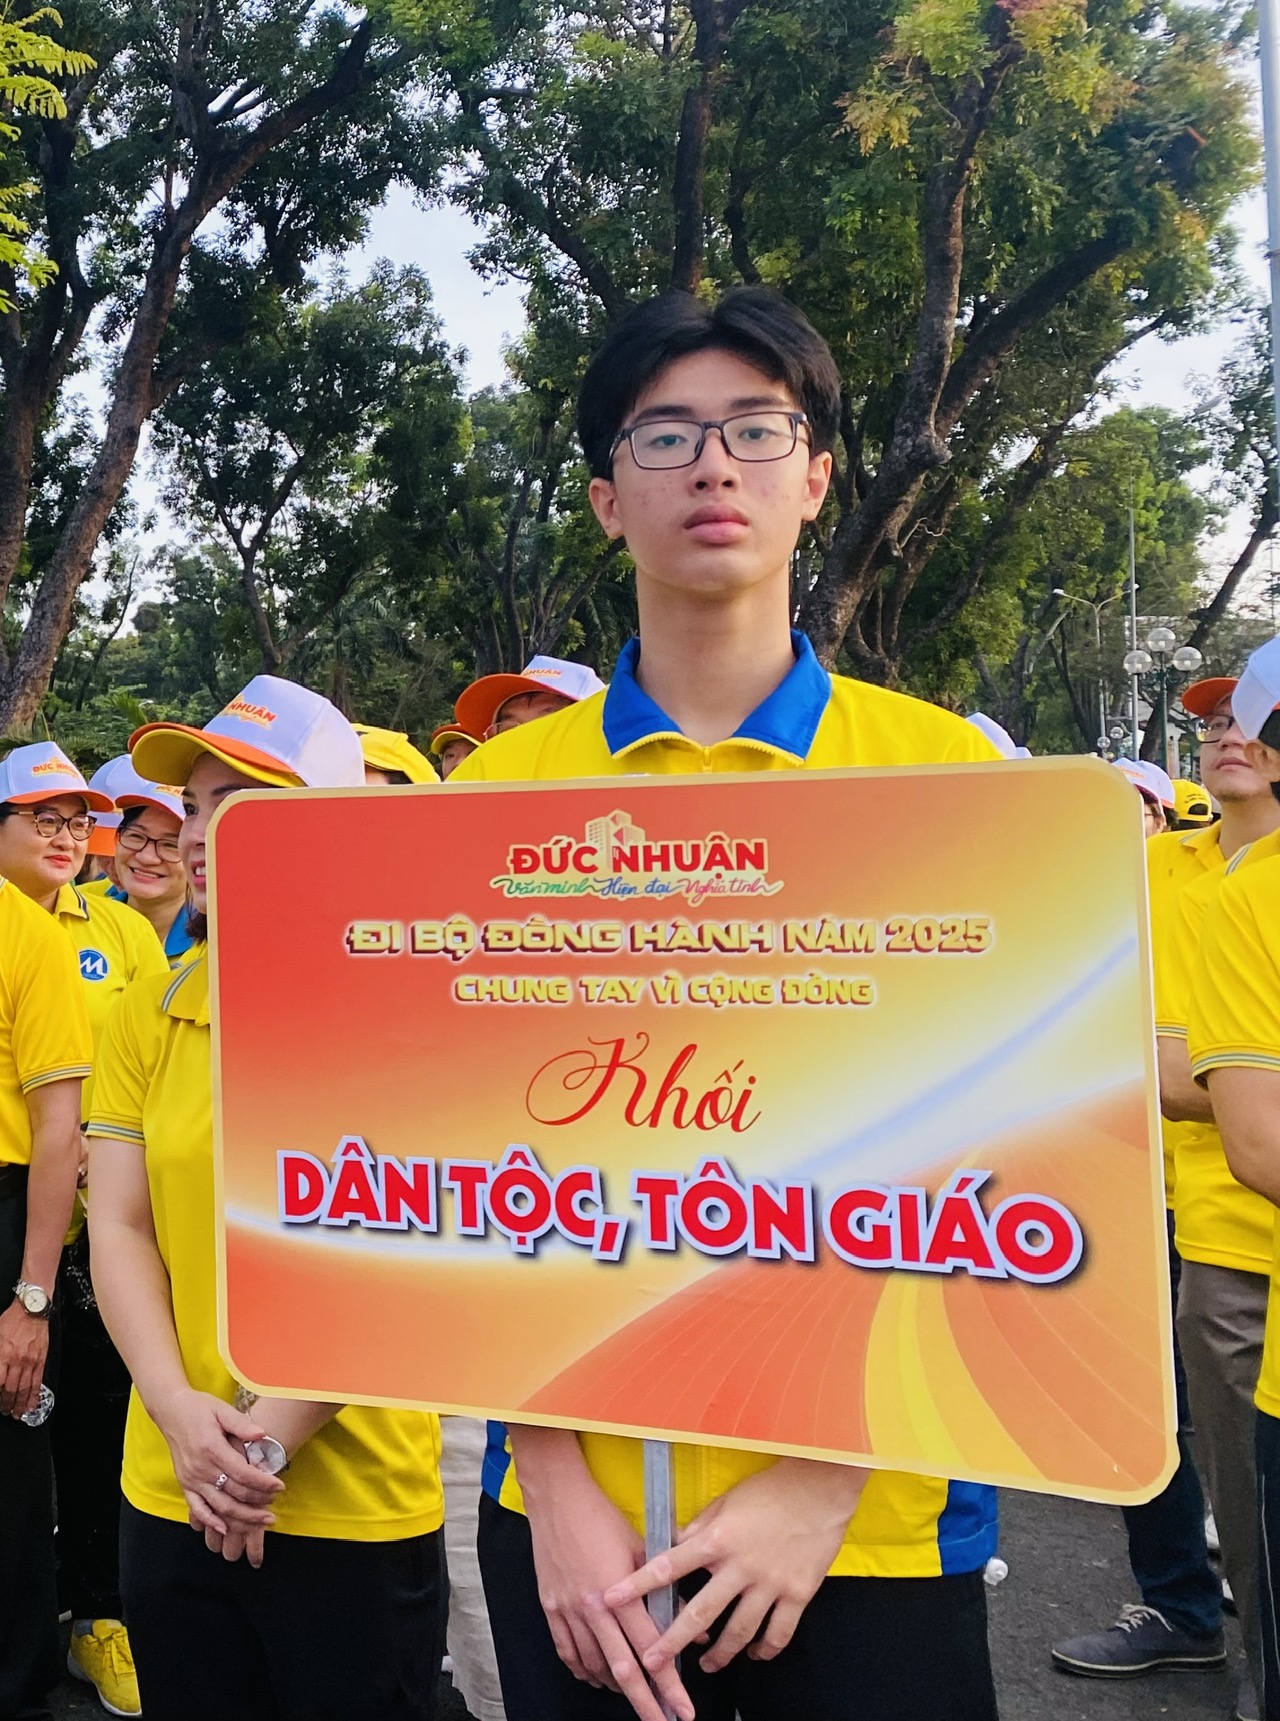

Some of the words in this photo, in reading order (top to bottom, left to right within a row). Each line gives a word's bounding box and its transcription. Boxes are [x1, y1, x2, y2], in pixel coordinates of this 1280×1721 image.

[510, 838, 599, 875] ĐỨC
[611, 833, 766, 880] NHUẬN
[345, 922, 403, 955] ĐI
[410, 916, 476, 962] BỘ
[480, 915, 623, 954] ĐỒNG
[630, 918, 775, 954] HÀNH
[885, 917, 993, 954] 2025
[455, 976, 571, 1004] CHUNG
[579, 977, 646, 1004] TAY
[651, 971, 681, 1004] VÌ
[688, 972, 773, 1008] CỘNG
[525, 1031, 762, 1133] Khối
[278, 1137, 437, 1231] DÂN
[444, 1145, 627, 1259] TỘC,
[633, 1157, 813, 1260] TÔN
[824, 1171, 1082, 1282] GIÁO
